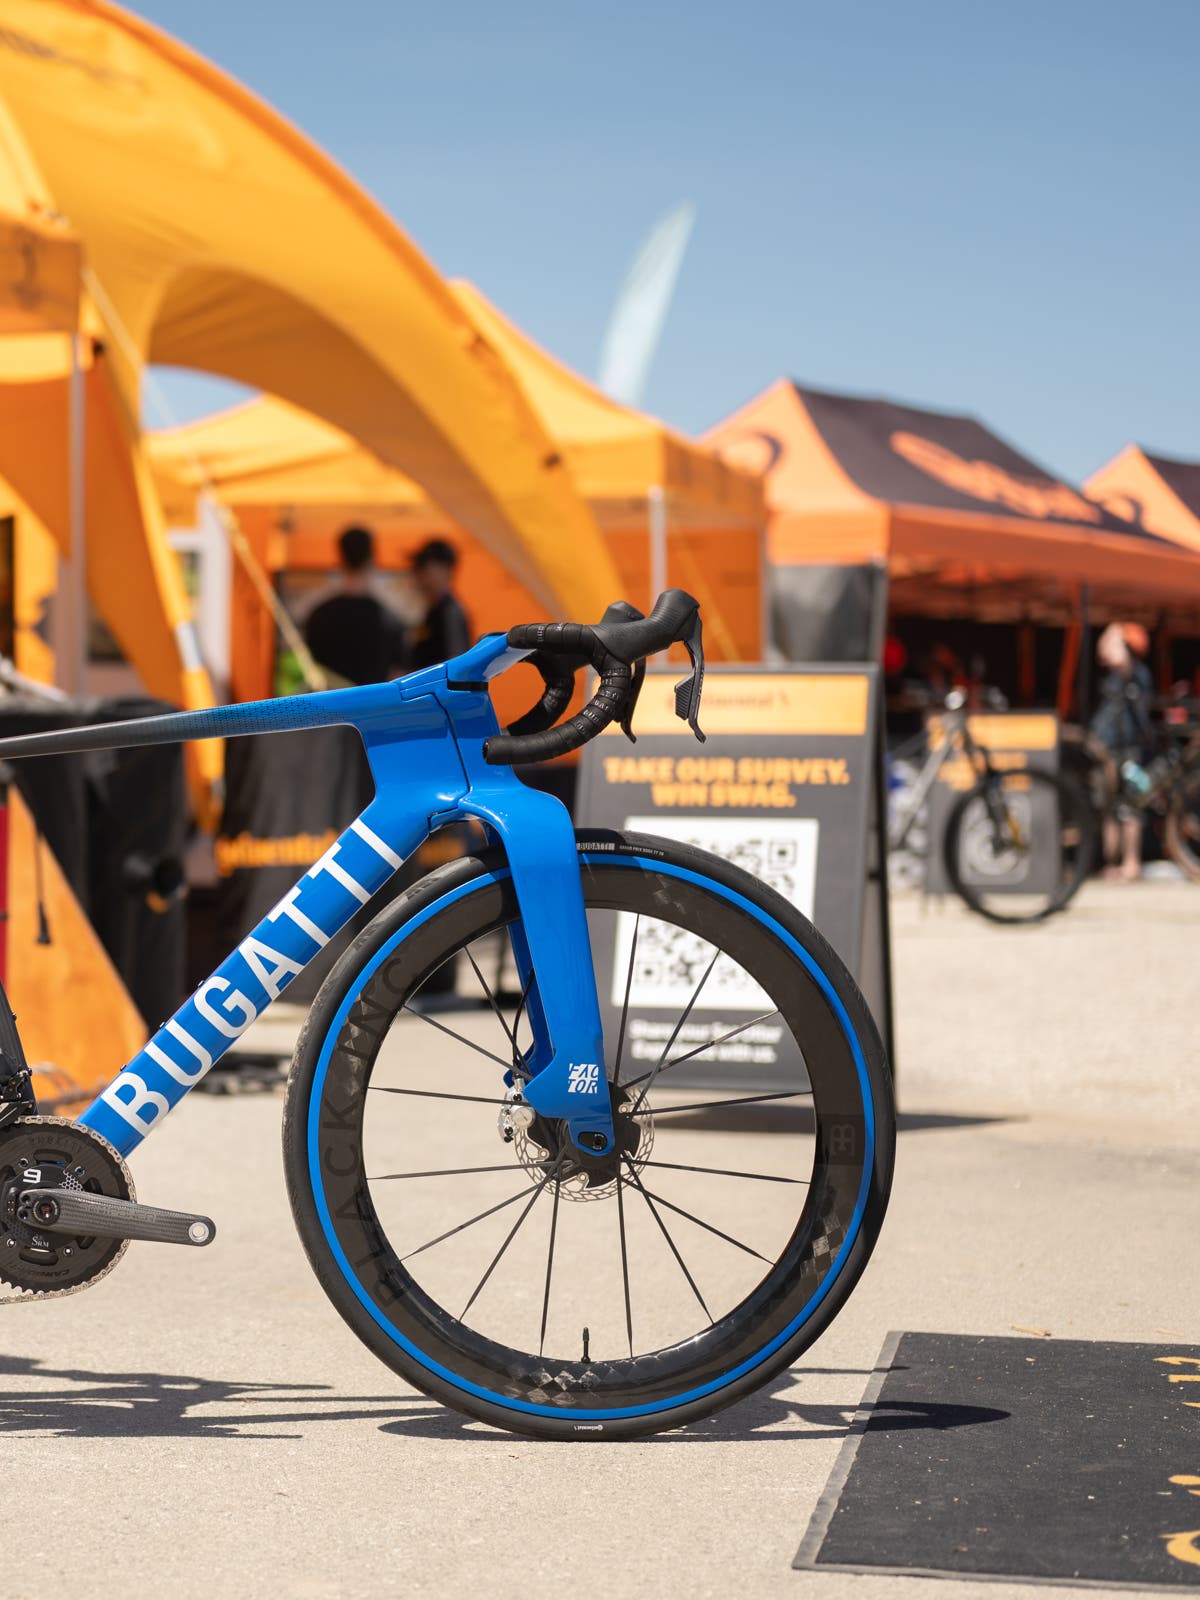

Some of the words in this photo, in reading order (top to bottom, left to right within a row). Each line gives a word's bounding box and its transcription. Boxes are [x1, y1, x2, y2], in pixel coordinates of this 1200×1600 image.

[604, 757, 673, 783] TAKE
[676, 757, 735, 784] OUR
[738, 758, 850, 785] SURVEY.
[652, 782, 708, 806] WIN
[710, 783, 797, 808] SWAG.
[101, 818, 404, 1138] BUGATTI
